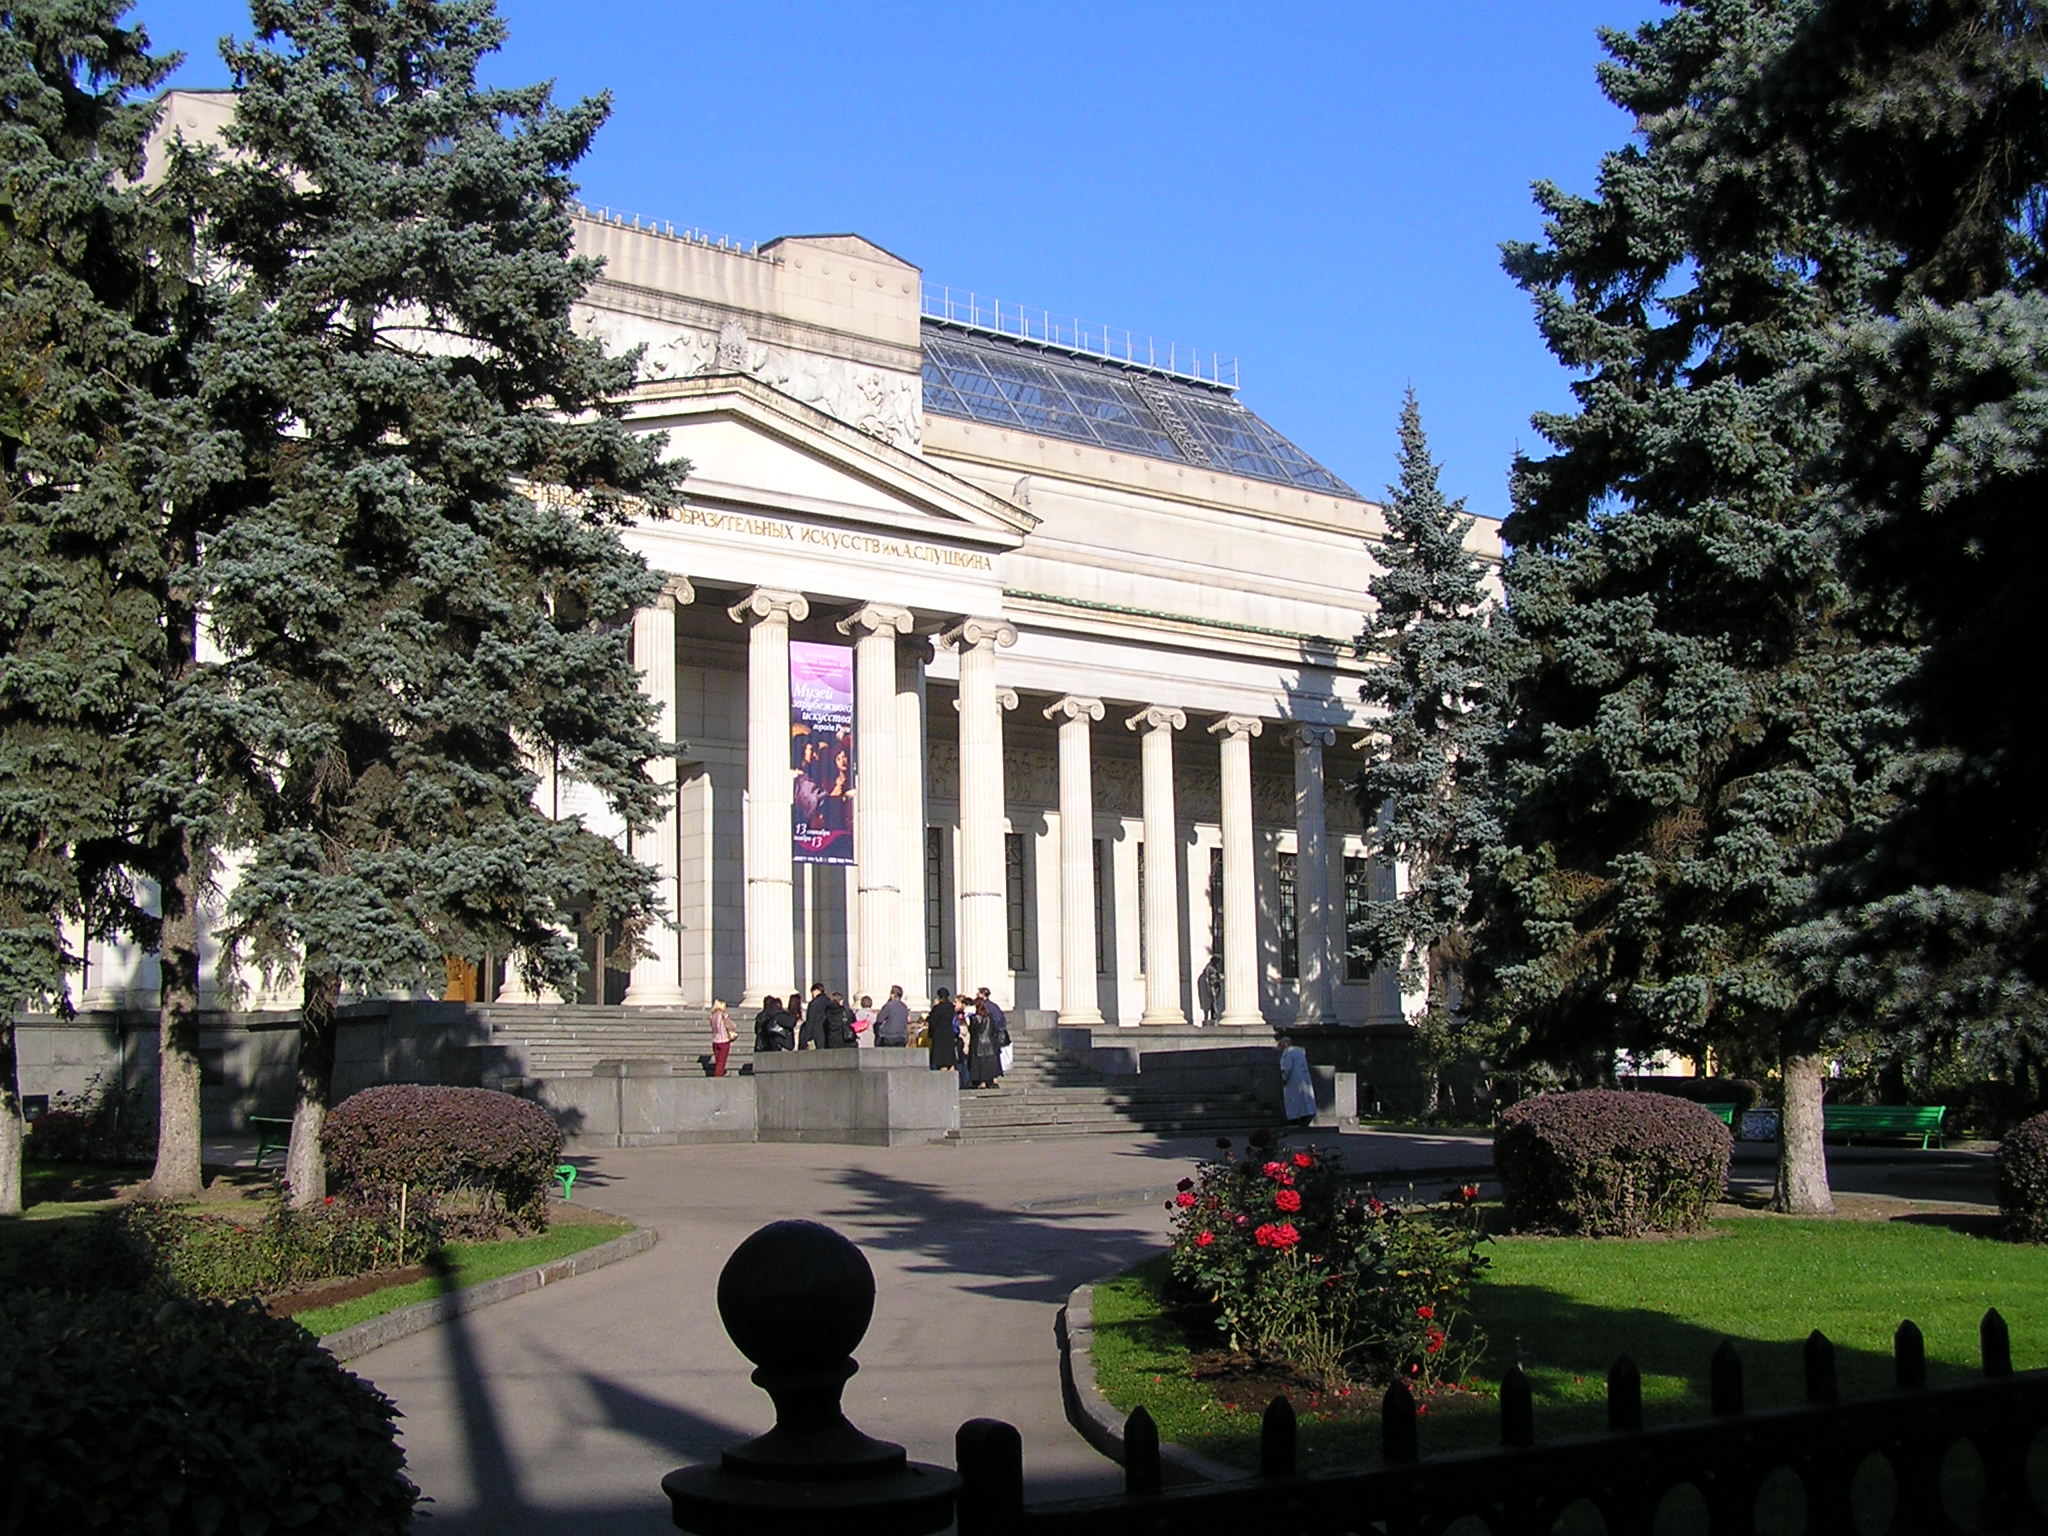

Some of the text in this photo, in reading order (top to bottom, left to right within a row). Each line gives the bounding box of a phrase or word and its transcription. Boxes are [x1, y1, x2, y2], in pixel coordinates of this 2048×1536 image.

[666, 505, 794, 540] ОБРАЗИТЕЛЬНЫХ
[800, 527, 880, 553] ИСКУССТВ
[793, 682, 834, 700] Музей
[802, 712, 851, 724] искусства
[795, 823, 807, 835] 13
[811, 836, 823, 848] 13
